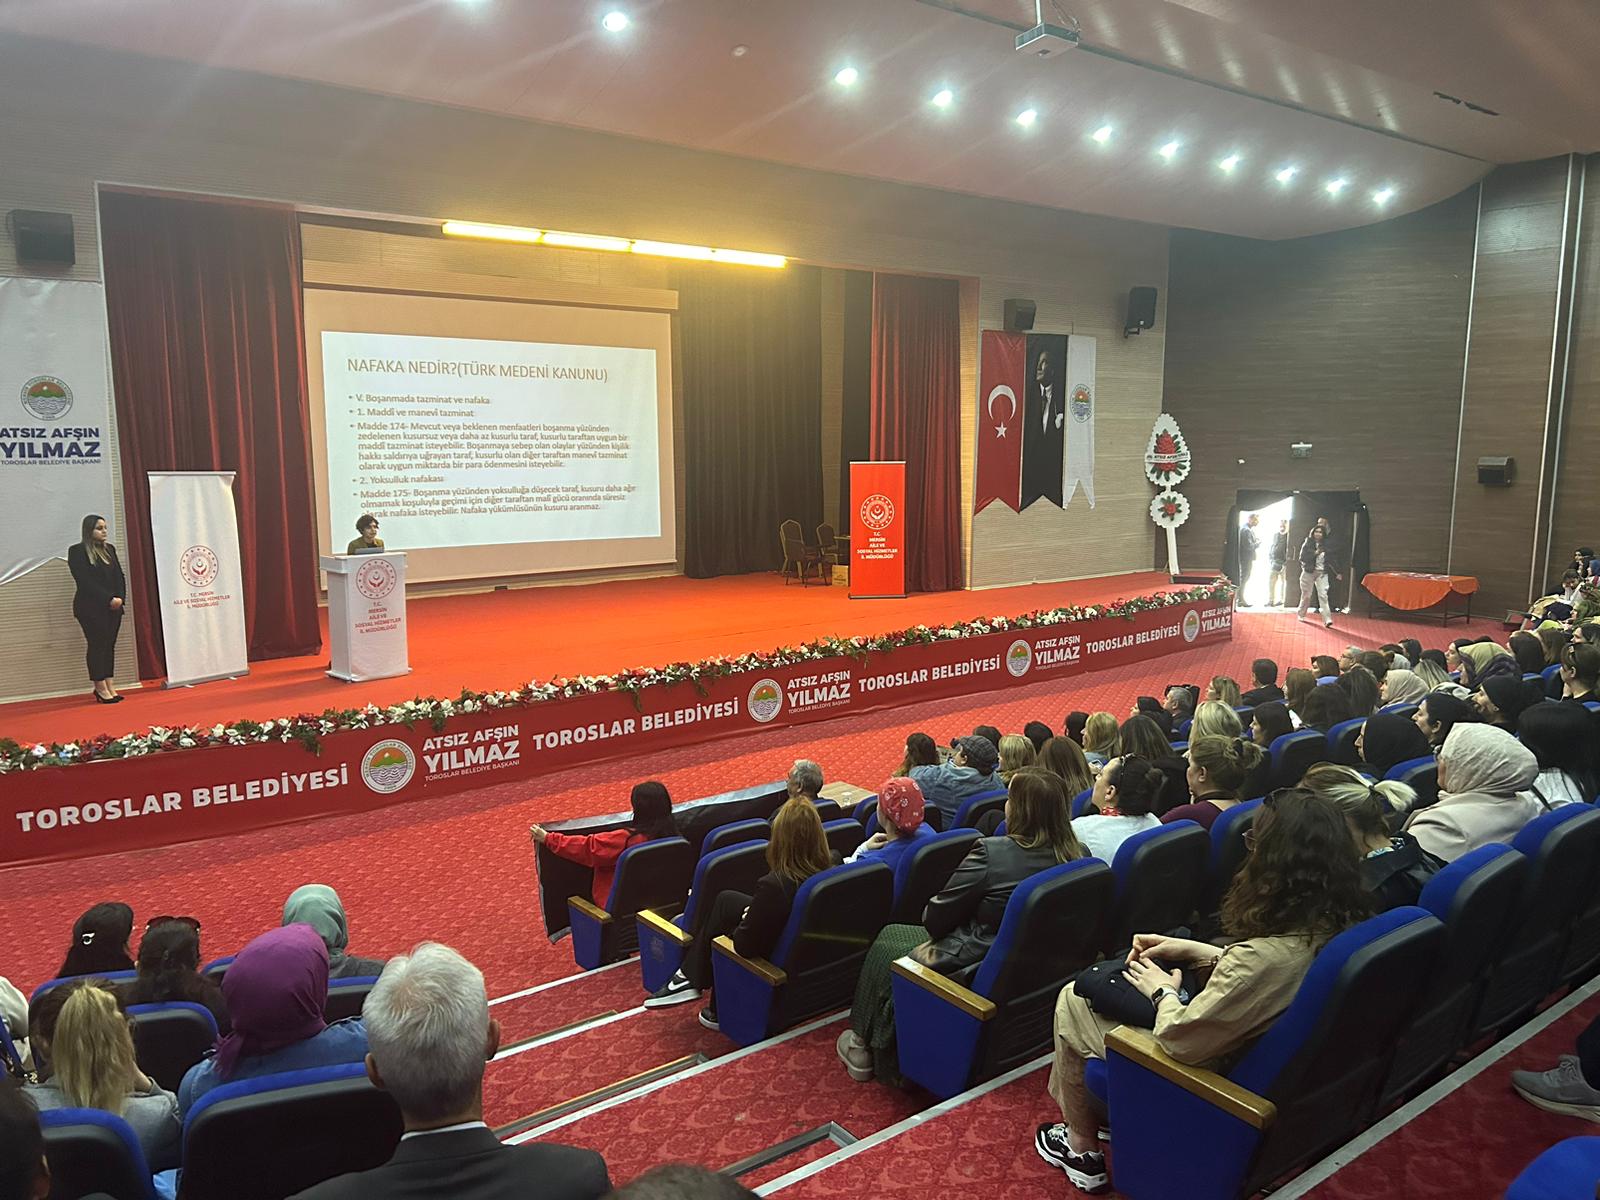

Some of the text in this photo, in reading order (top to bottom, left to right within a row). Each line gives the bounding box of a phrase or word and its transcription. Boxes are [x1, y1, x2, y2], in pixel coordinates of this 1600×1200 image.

[348, 359, 608, 383] NAFAKA NEDİR?(TÜRK MEDENİ KANUNU)
[356, 394, 362, 402] V.
[366, 394, 415, 404] Boşanmada
[417, 396, 451, 404] tazminat
[465, 396, 490, 404] nafaka
[440, 409, 474, 417] tazminat
[0, 427, 99, 441] ATSIZ AFŞIN
[403, 432, 438, 440] kusursuz
[440, 434, 458, 442] veya
[460, 432, 479, 440] daha
[520, 433, 538, 441] taraf,
[568, 433, 595, 441] taraftan
[597, 435, 617, 443] uygun
[443, 424, 460, 432] veya
[543, 424, 575, 434] boşanma
[577, 425, 609, 434] yüzünden
[0, 442, 101, 458] YILMAZ
[1202, 616, 1230, 632] YILMAZ
[1035, 635, 1080, 649] ATSIZ AFŞIN
[1086, 636, 1135, 654] TOROSLAR
[1136, 623, 1180, 645] BELEDİYESİ
[1035, 646, 1080, 665] YILMAZ
[787, 670, 850, 689] ATSIZ AFŞIN
[858, 668, 928, 693] TOROSLAR
[932, 654, 1000, 681] BELEDİYESİ
[787, 683, 850, 707] YILMAZ
[533, 718, 636, 751] TOROSLAR
[641, 697, 739, 732] BELEDİYESİ
[423, 725, 519, 751] ATSIZ AFŞIN
[423, 740, 520, 774] YILMAZ
[425, 760, 519, 782] TOROSLAR BELEDİYE BAŞKANI
[16, 791, 182, 832] TOROSLAR
[193, 763, 349, 808] BELEDİYESİ
